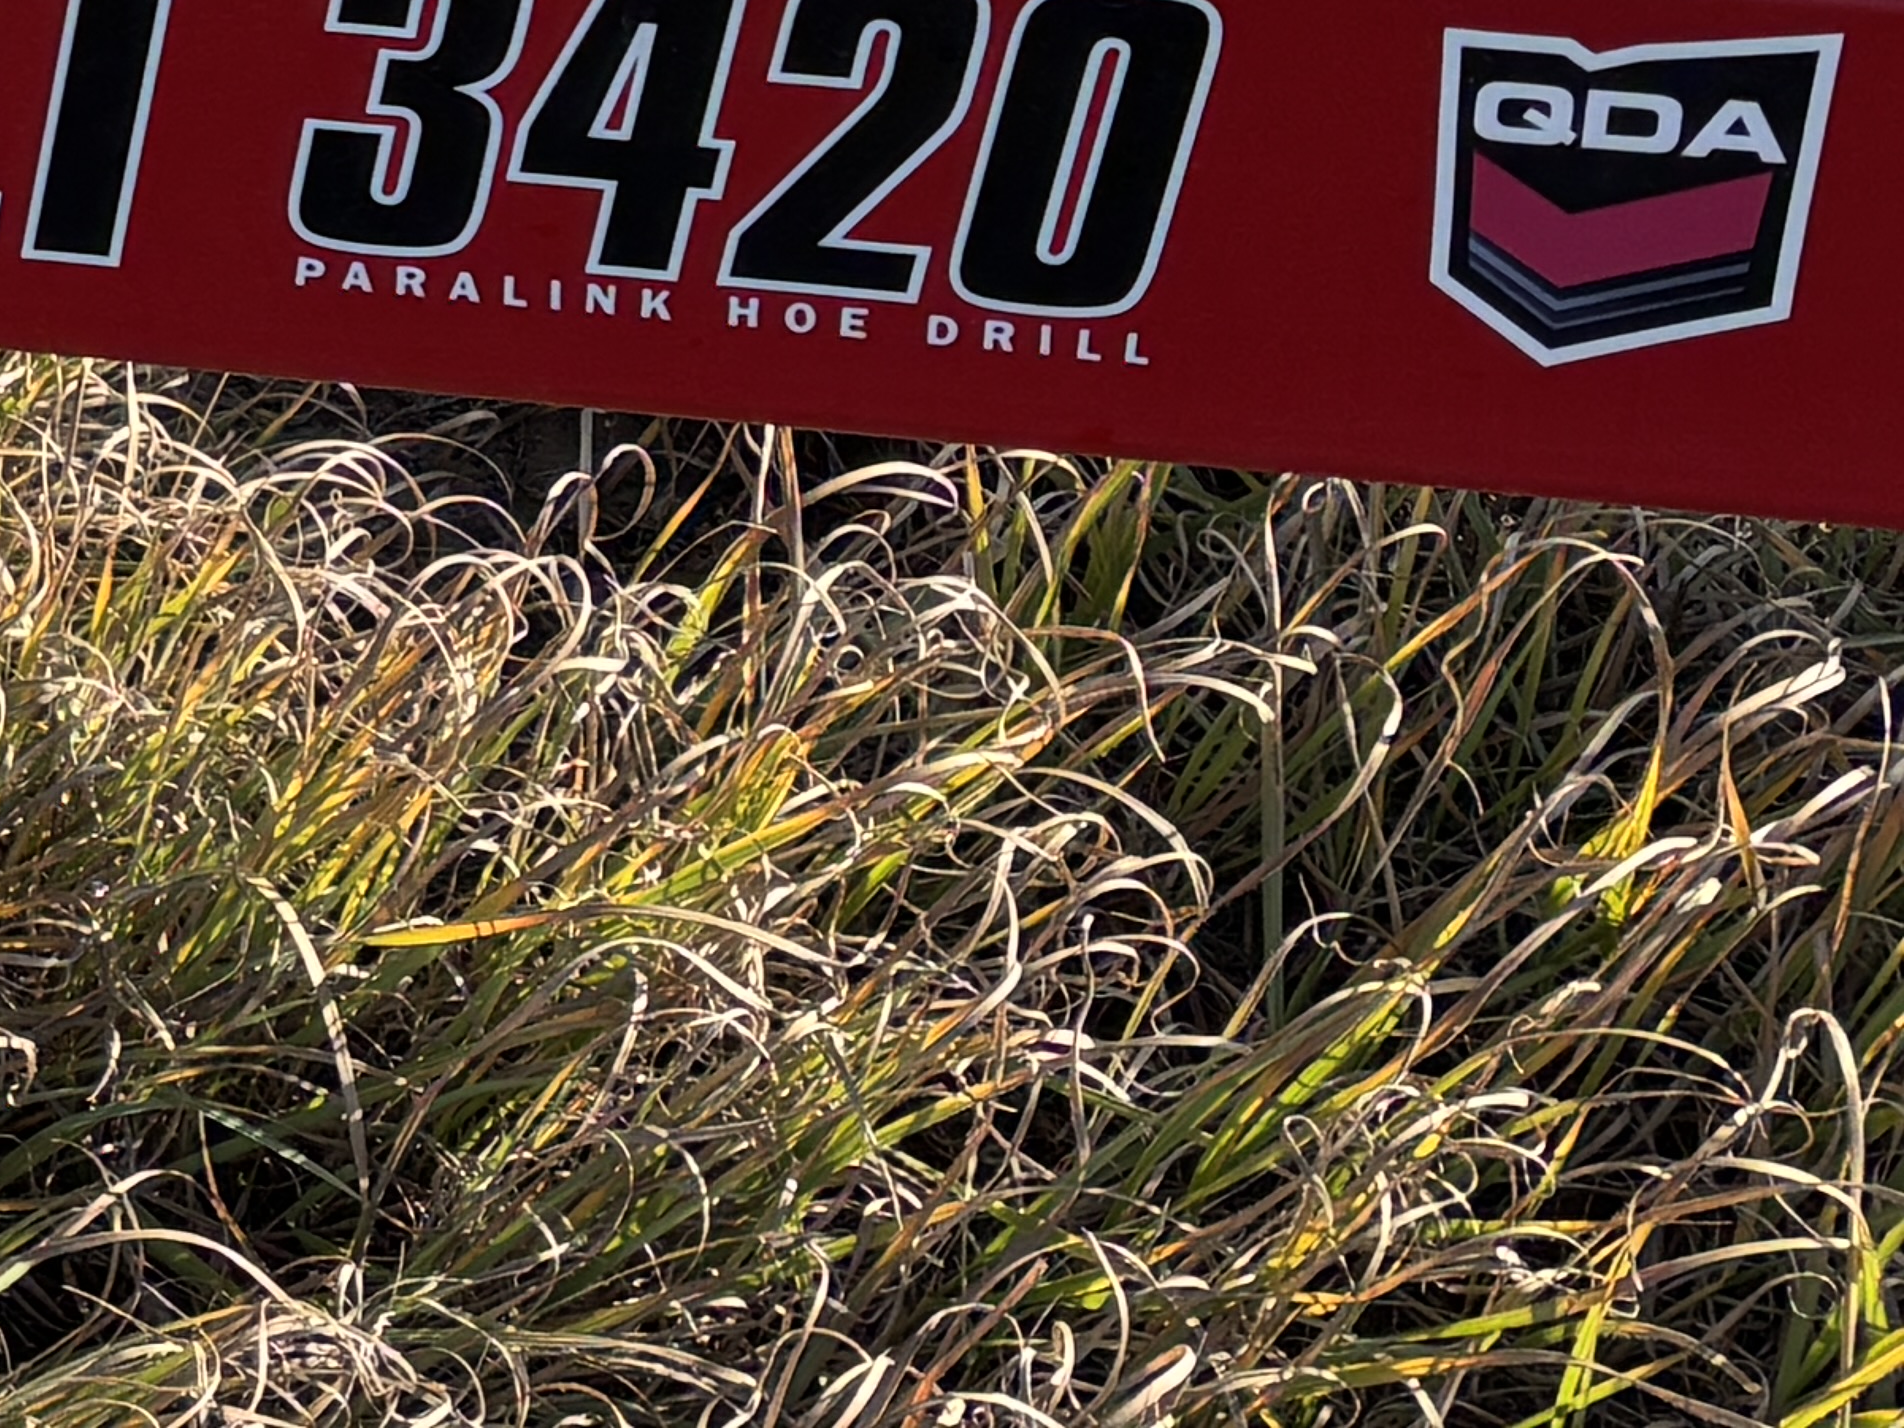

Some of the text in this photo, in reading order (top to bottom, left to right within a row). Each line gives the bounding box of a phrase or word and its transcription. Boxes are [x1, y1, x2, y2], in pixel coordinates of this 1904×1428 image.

[1473, 80, 1788, 165] QDA
[293, 254, 1151, 366] PARALINK HOE DRILL
